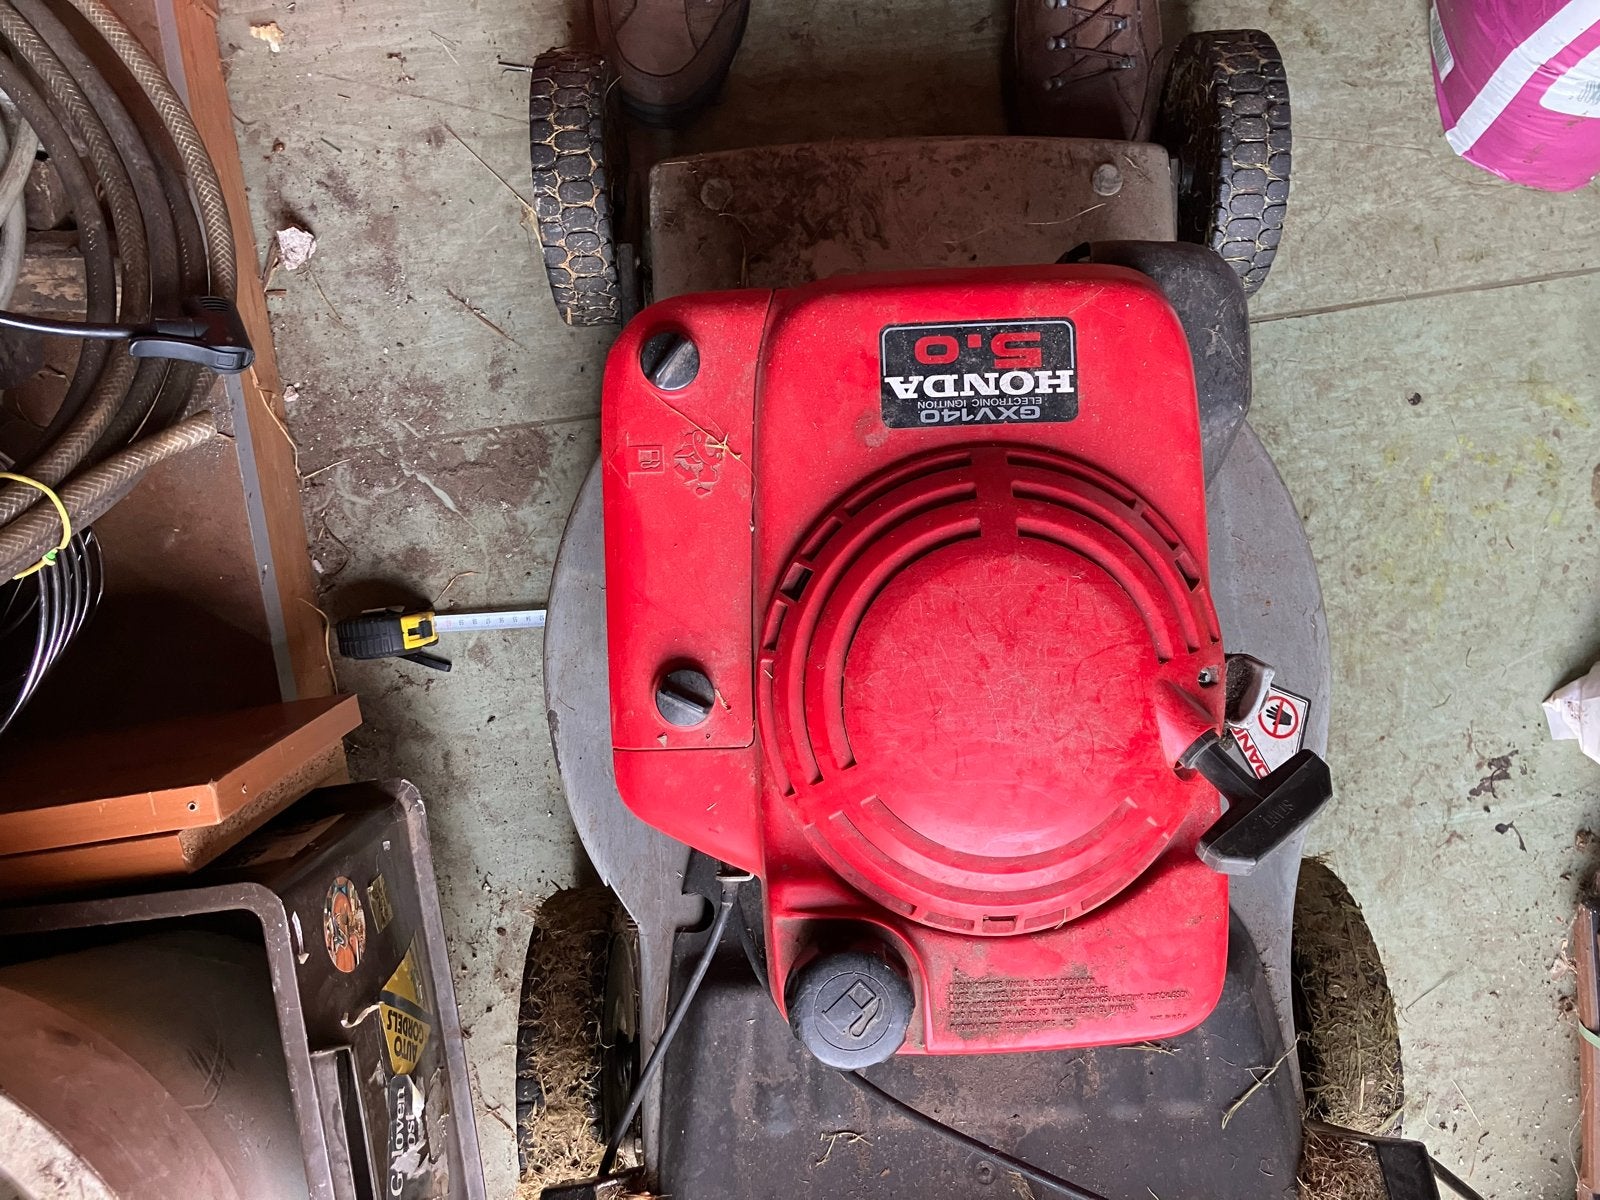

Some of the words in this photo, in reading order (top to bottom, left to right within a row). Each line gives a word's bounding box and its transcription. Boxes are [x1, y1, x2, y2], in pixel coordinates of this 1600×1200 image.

[914, 332, 1042, 368] 5.0
[884, 370, 1074, 399] HONDA
[917, 400, 966, 409] IGNITION
[920, 406, 1041, 423] GXV140
[972, 397, 1042, 406] ELECTRONIC
[1263, 799, 1294, 828] START
[394, 1036, 418, 1064] AUTO
